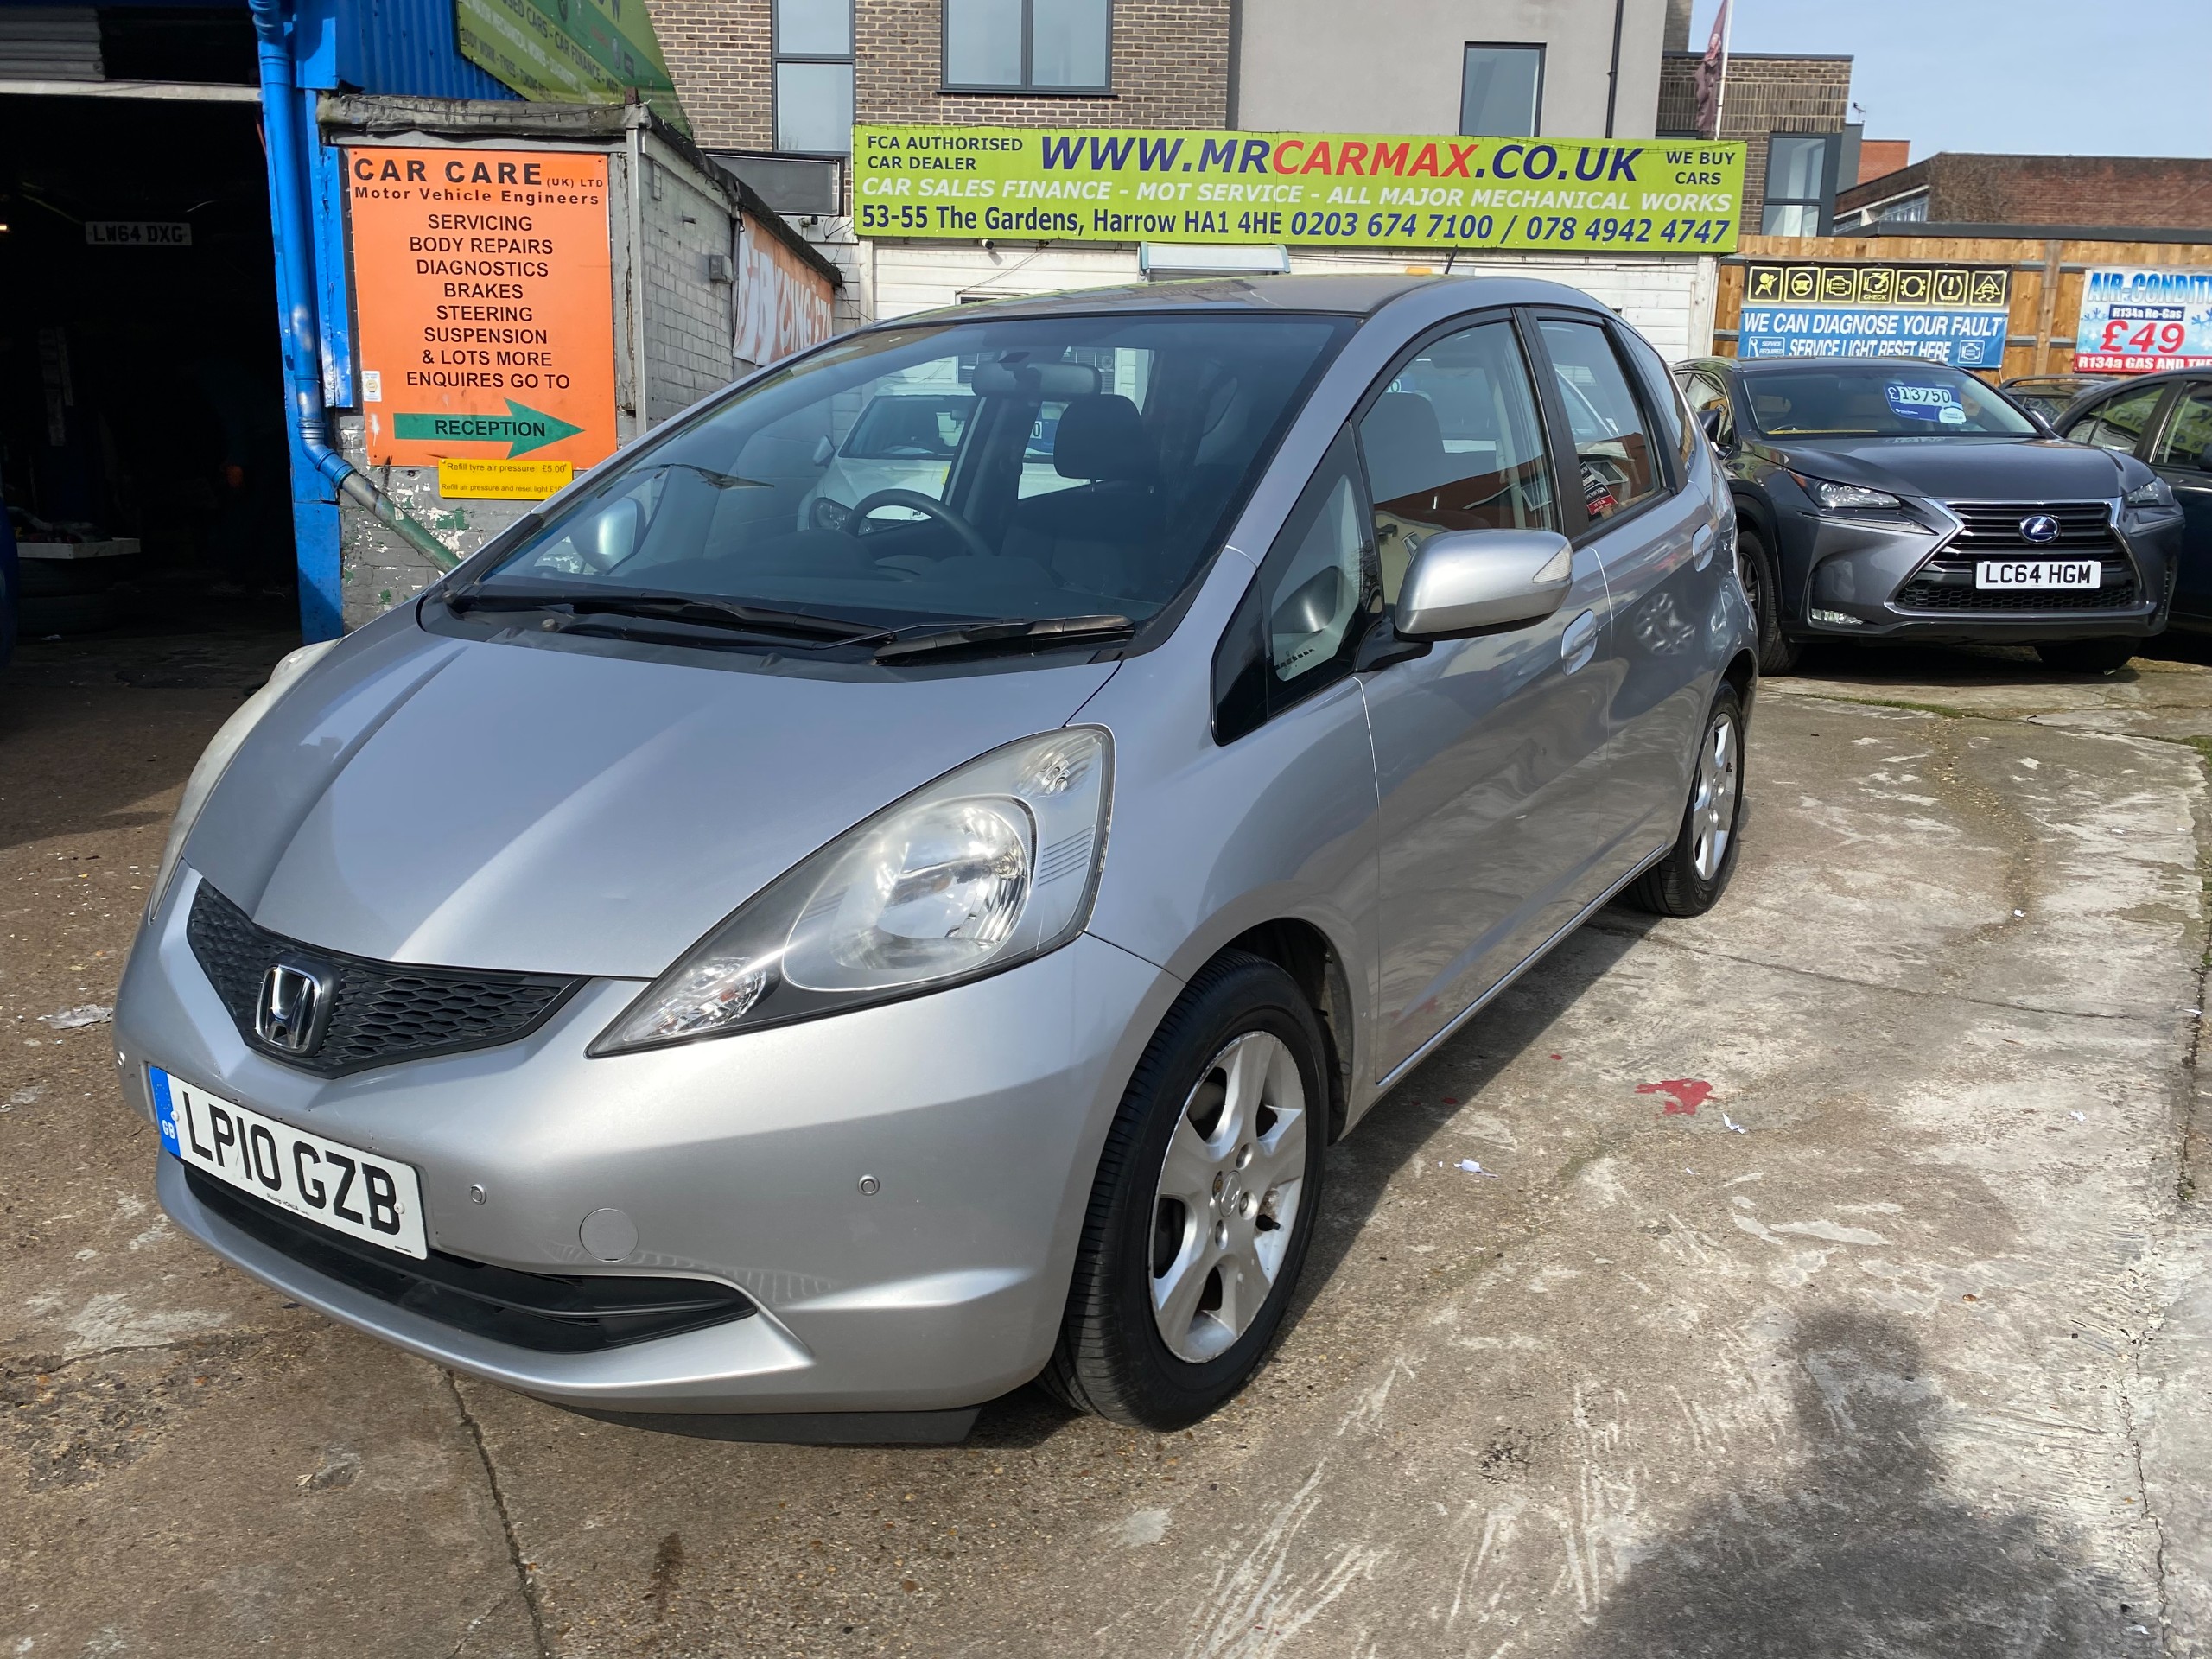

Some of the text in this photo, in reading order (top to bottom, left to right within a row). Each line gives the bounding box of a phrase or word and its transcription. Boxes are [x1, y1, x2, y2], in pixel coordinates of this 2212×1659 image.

[527, 6, 548, 39] CARS
[555, 31, 570, 58] CAR
[571, 44, 601, 83] FINANCE
[868, 136, 1023, 151] FCA AUTHORISED
[868, 156, 976, 170] CAR DEALER
[1042, 136, 1645, 181] WWW.MRCARMAX.CO.UK
[1667, 151, 1735, 165] WE BUY
[353, 158, 603, 188] CAR CARE (UK) LTD
[1675, 172, 1721, 185] CARS
[354, 187, 599, 206] Motor Vehicle Engineers
[862, 177, 911, 196] CAR
[918, 179, 995, 198] SALES
[1002, 180, 1112, 199] FINANCE
[1136, 181, 1192, 200] MOT
[1197, 183, 1304, 204] SERVICE
[1326, 186, 1370, 206] ALL
[1379, 187, 1464, 207] MAJOR
[1471, 189, 1630, 210] MECHANICAL
[1642, 192, 1732, 212] WORKS
[428, 213, 532, 232] SERVICING
[862, 204, 1731, 244] 53-55 The Gardens, Harrow HA1 4HE 0203 674 7100 / 078 4942 4747
[92, 225, 185, 243] LW64 DXG
[410, 236, 553, 255] BODY REPAIRS
[416, 259, 549, 277] DIAGNOSTICS
[443, 283, 524, 300] BRAKES
[436, 305, 533, 321] STEERING
[2112, 307, 2183, 320] R134a Re-Gas
[1745, 312, 2004, 337] WE CAN DIAGNOSE YOUR FAULT
[423, 327, 548, 344] SUSPENSION
[2099, 320, 2186, 354] £49
[422, 350, 553, 367] & LOTS MORE
[1789, 338, 1840, 357] SERVICE
[1918, 340, 1952, 362] HERE
[2078, 356, 2123, 369] R134a
[2126, 356, 2154, 370] GAS
[2156, 357, 2184, 371] AND
[406, 371, 570, 390] ENQUIRES GO TO
[1887, 386, 1952, 404] £13750
[435, 419, 545, 437] RECEPTION
[447, 462, 467, 471] Refill
[469, 463, 485, 473] tyre
[486, 463, 497, 472] air
[499, 465, 535, 474] pressure
[1986, 563, 2092, 584] LC64 HGM
[162, 1118, 176, 1140] GB
[182, 1090, 401, 1236] LP10 GZB
